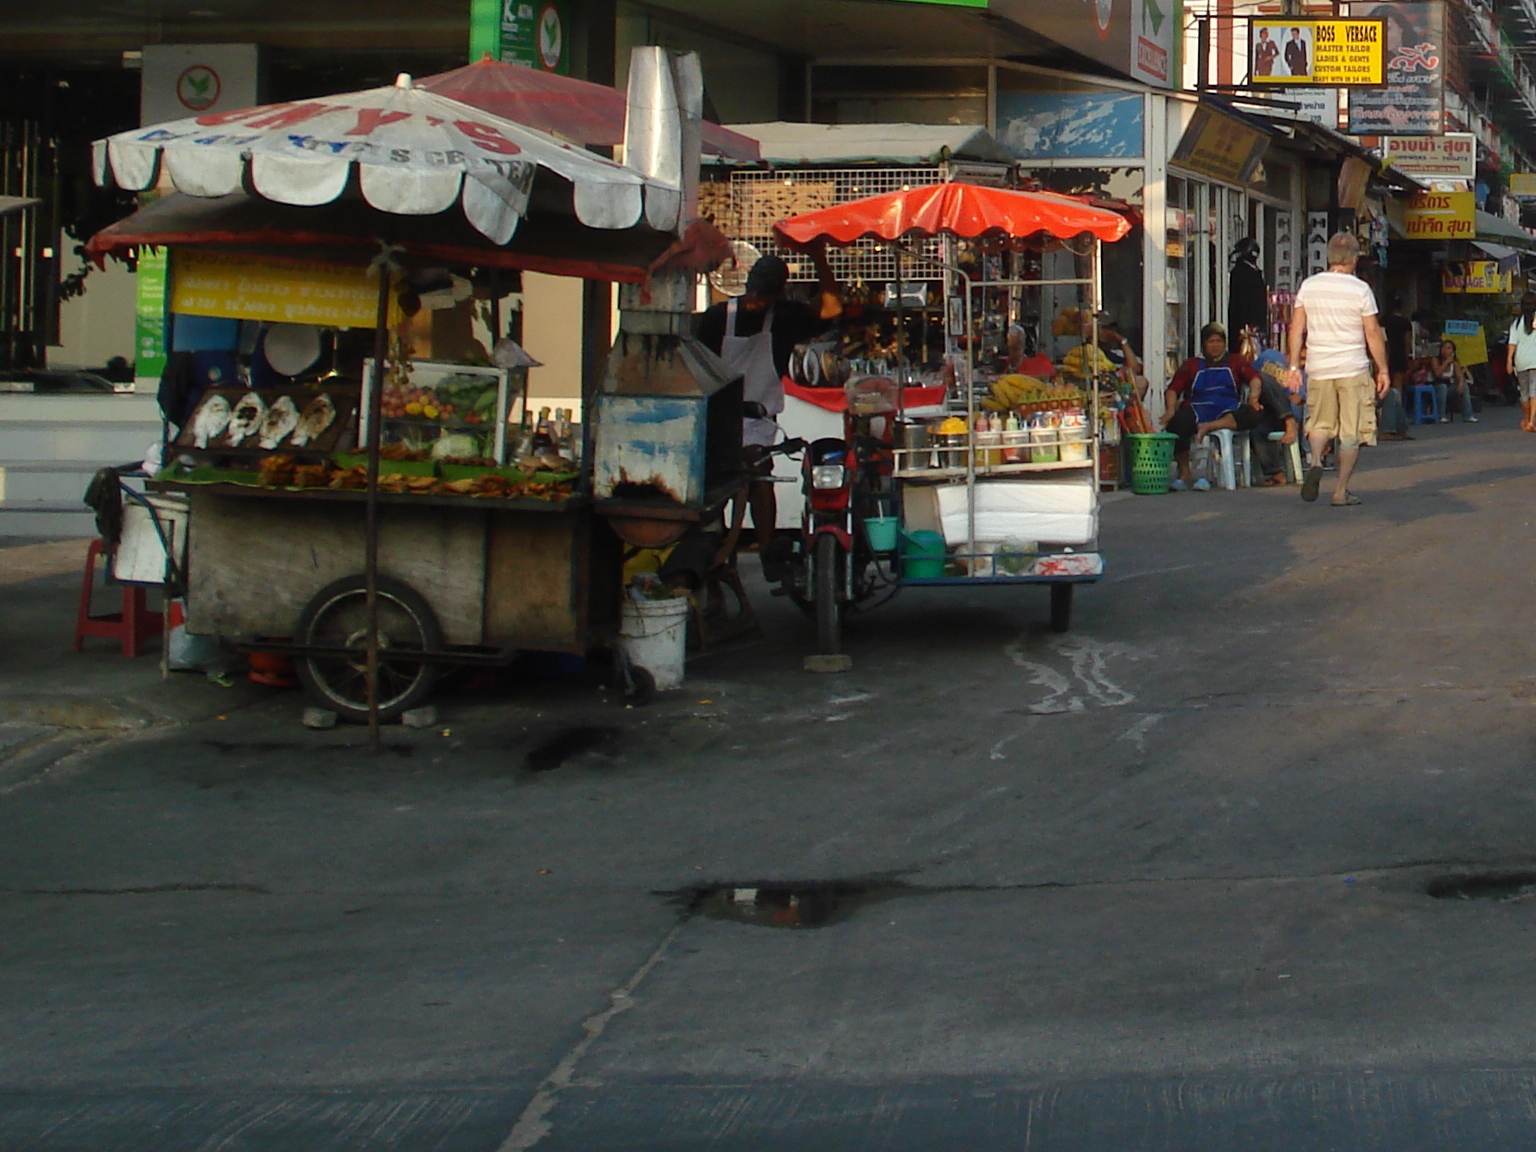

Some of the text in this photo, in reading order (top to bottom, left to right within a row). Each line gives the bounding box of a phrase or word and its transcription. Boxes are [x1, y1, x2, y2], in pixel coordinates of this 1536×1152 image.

[1316, 24, 1378, 43] BOSS VERSACE
[1316, 44, 1371, 53] MASTER TAILOR
[1316, 55, 1339, 63] LADIES
[1349, 55, 1370, 63] GENTS
[1314, 65, 1371, 73] CUSTOM TAILORS
